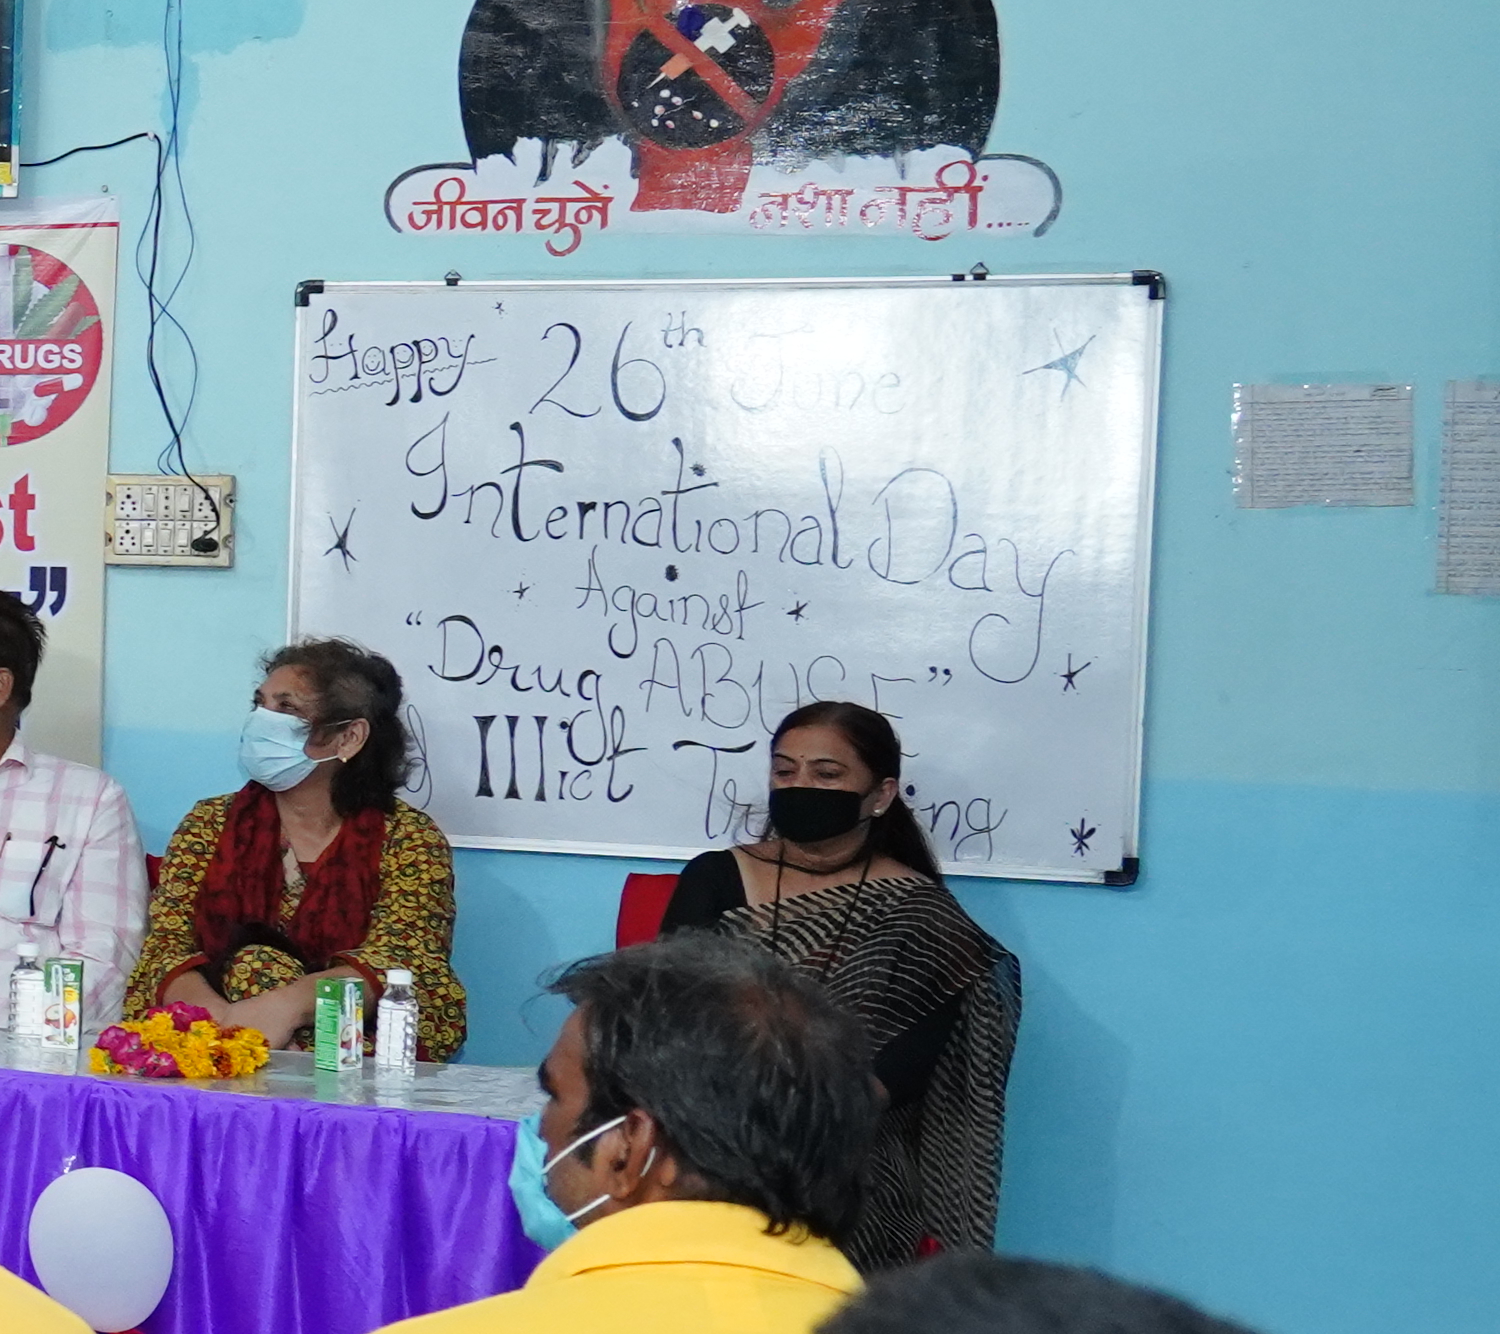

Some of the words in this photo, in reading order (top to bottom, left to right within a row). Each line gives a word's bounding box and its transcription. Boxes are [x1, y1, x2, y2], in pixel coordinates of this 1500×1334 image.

[408, 178, 523, 231] जीवन
[532, 182, 614, 256] चुनें
[748, 183, 856, 230] नशा
[308, 308, 476, 406] Happy
[729, 324, 905, 414] June
[575, 543, 764, 659] Against
[867, 467, 1077, 684] Day
